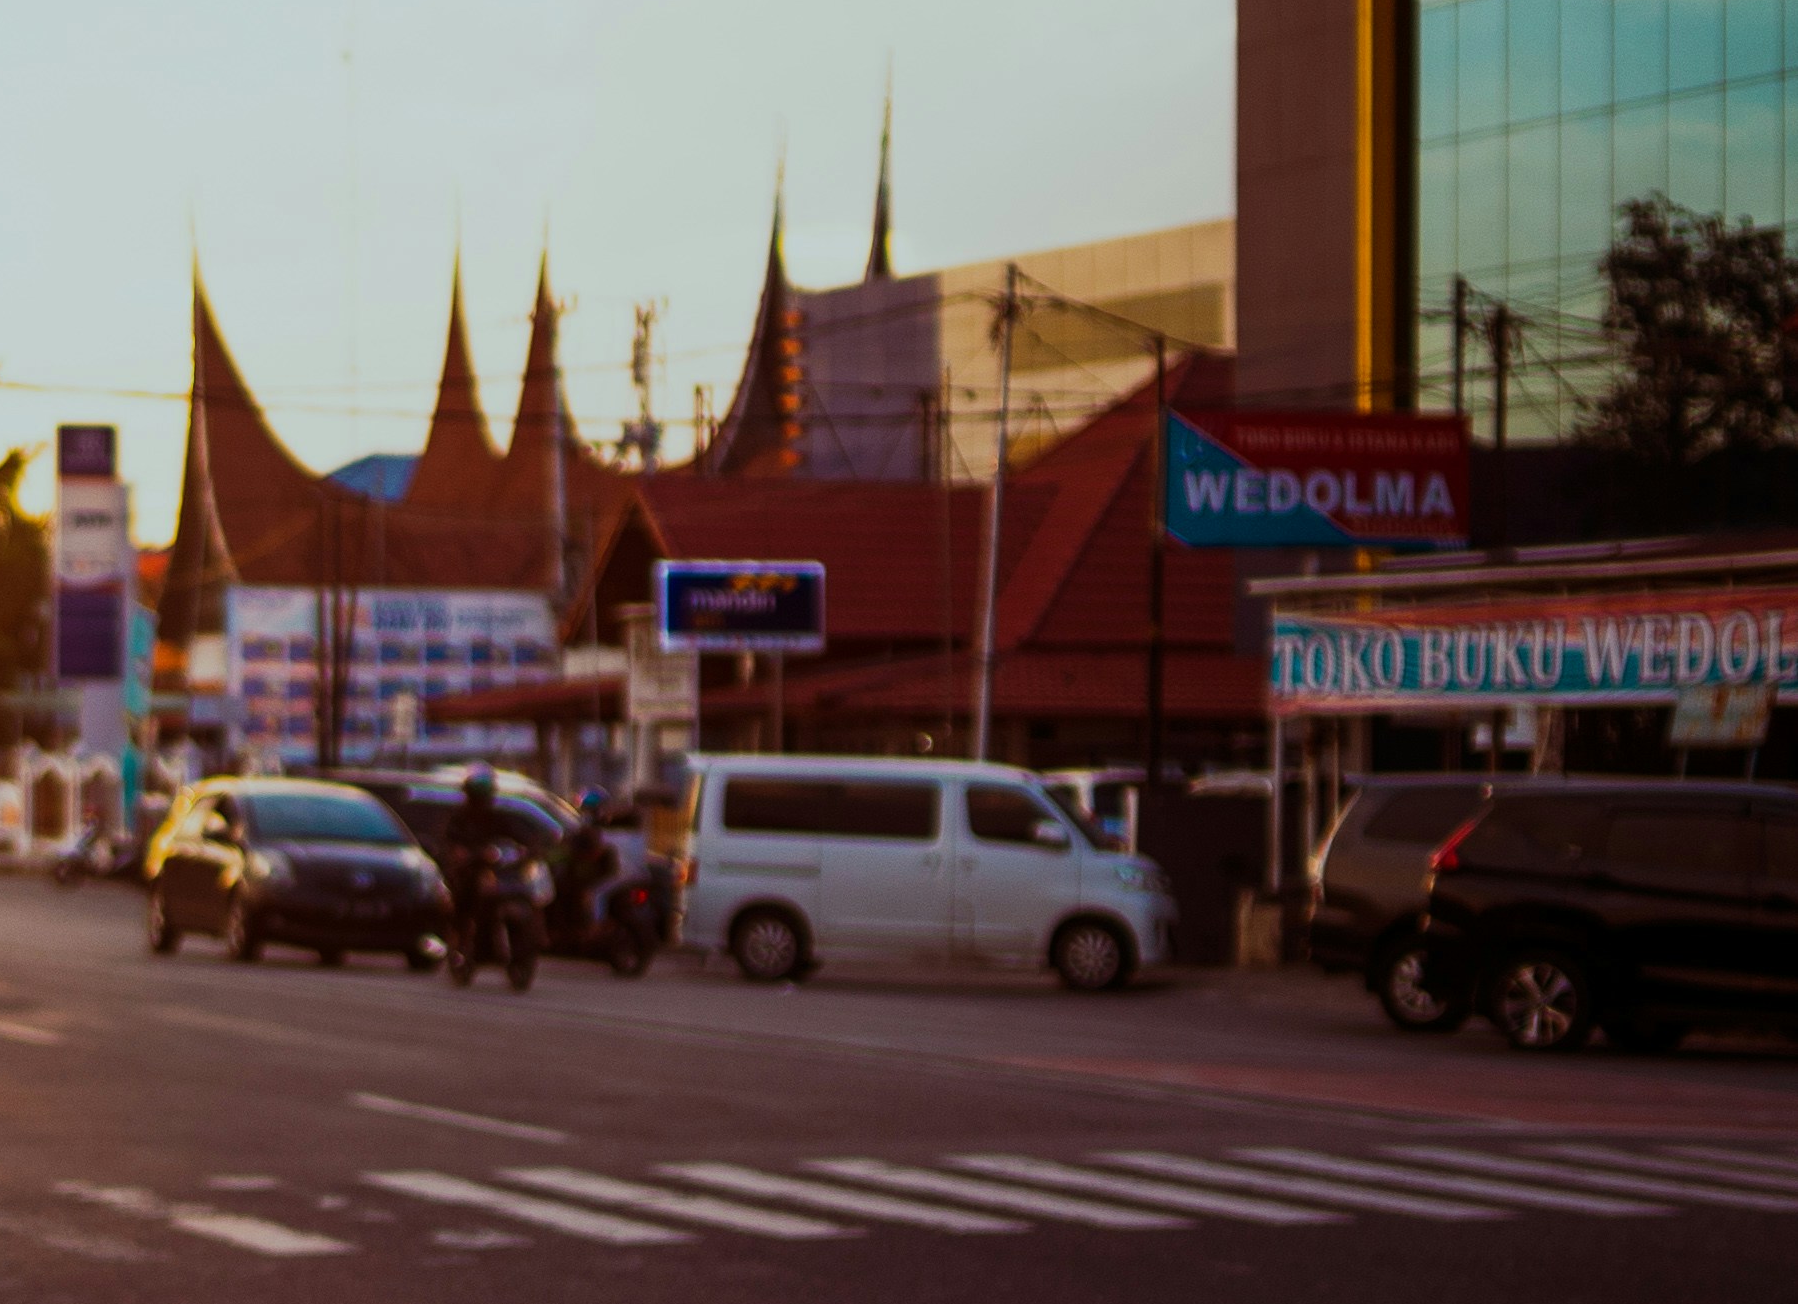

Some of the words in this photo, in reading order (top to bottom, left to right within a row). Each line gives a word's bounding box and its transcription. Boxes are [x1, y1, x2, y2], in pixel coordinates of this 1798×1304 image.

[1182, 468, 1456, 517] WEDOLMA
[1272, 629, 1405, 698] TOKO
[1416, 617, 1566, 691] BUKU
[1582, 608, 1797, 687] WEDOL
